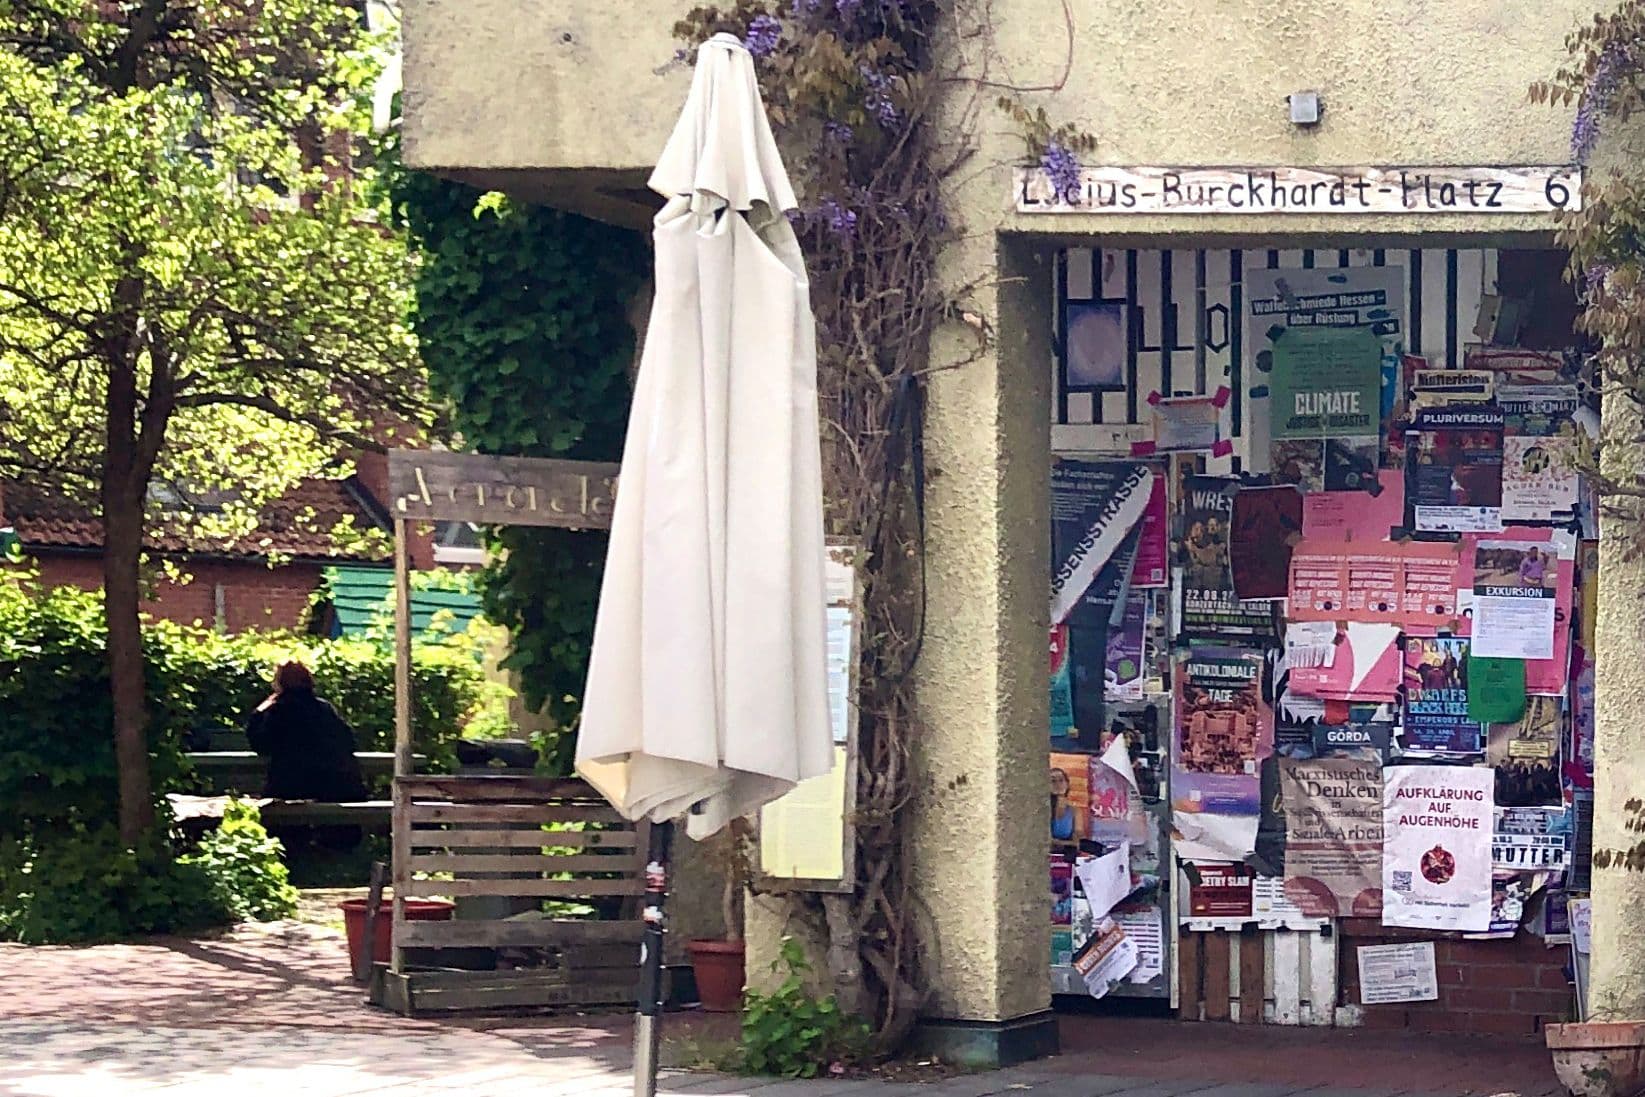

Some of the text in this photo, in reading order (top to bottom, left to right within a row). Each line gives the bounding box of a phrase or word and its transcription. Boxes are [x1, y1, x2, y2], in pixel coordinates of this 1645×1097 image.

[1544, 173, 1570, 208] 6
[1295, 391, 1360, 415] CLIMATE
[1423, 414, 1504, 424] PLURIVERSUM
[1049, 464, 1149, 598] ISSENSSTRASSE
[1486, 587, 1543, 598] EXKURSION
[1186, 664, 1257, 678] ANTIKOLONIALE
[1208, 688, 1234, 703] TAGE
[1307, 781, 1378, 798] Denken
[1396, 785, 1484, 801] AUFKLÄRUNG
[1428, 802, 1452, 814] AUF
[1399, 814, 1480, 829] AUGENHÖHE
